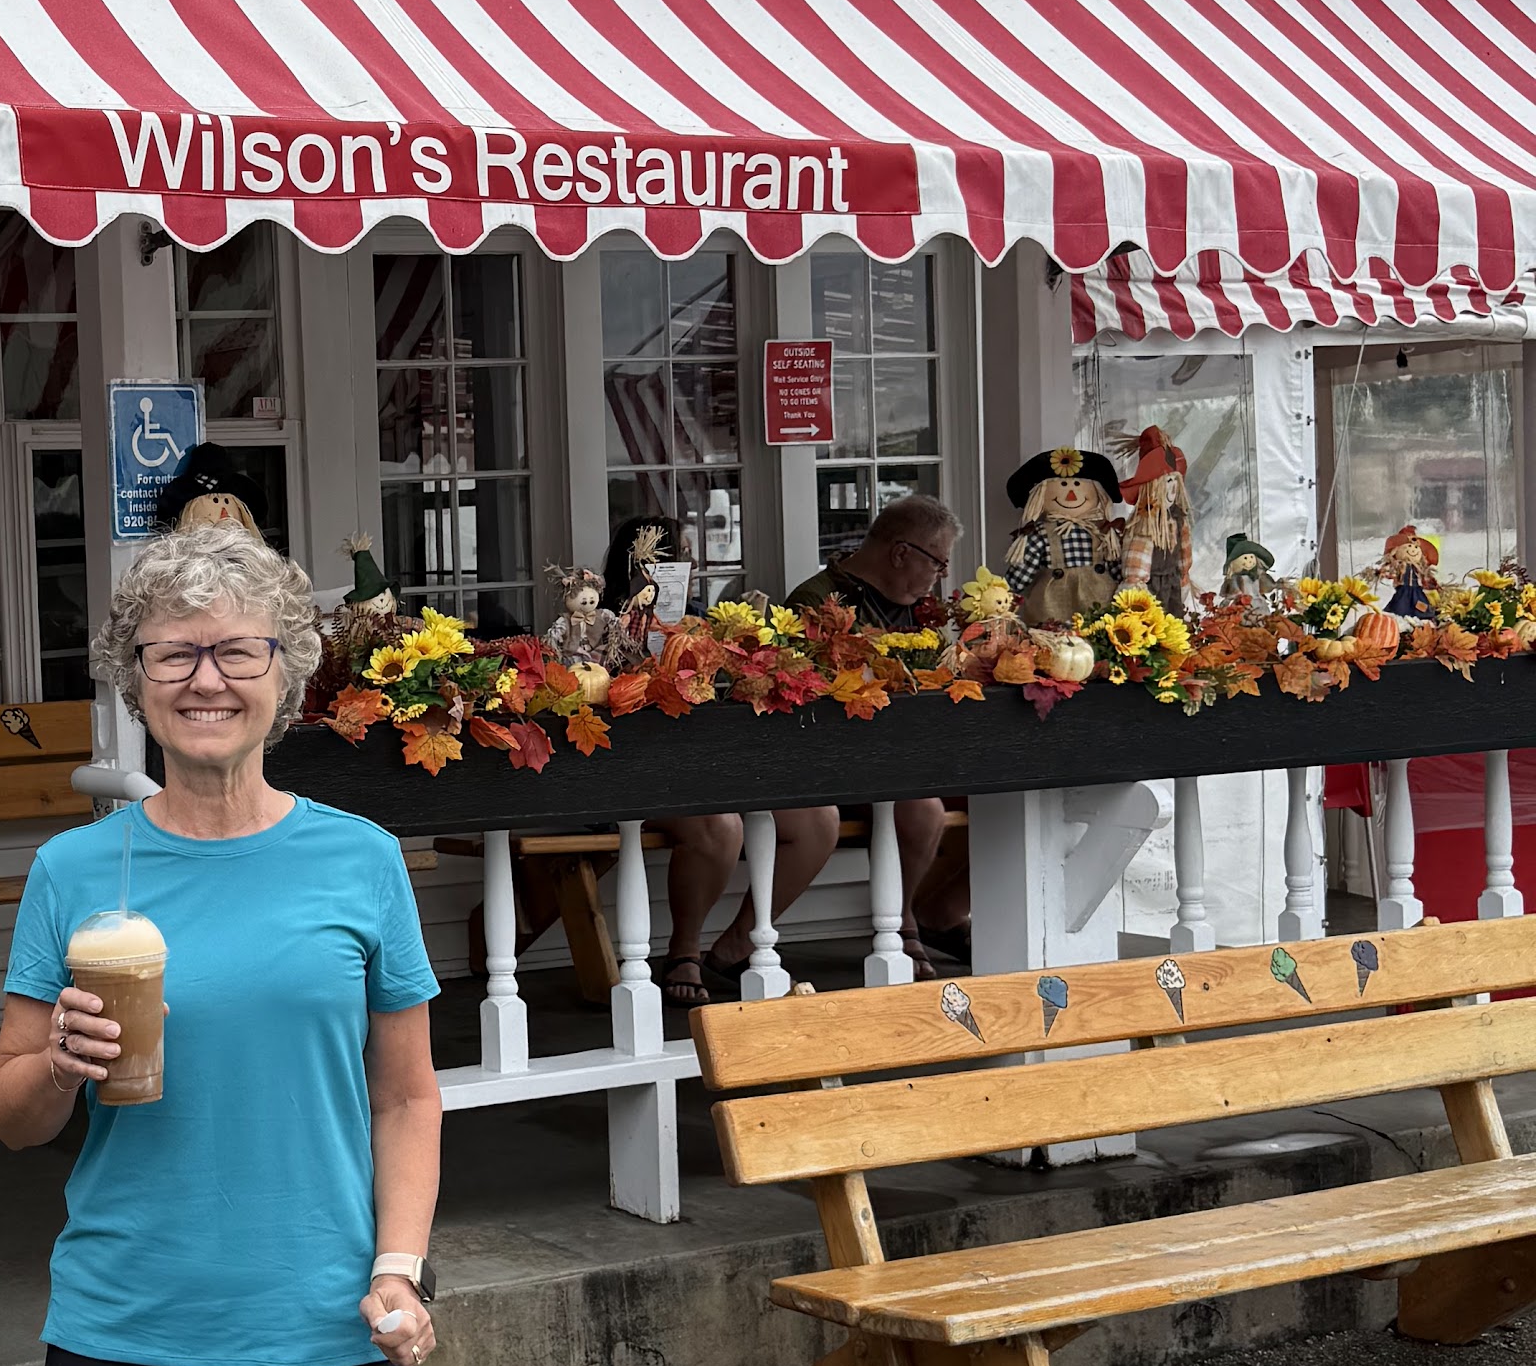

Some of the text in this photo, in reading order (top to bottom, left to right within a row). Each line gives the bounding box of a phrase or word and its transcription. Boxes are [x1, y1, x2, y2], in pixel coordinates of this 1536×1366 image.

[104, 109, 850, 213] Wilson's Restaurant
[784, 347, 816, 357] OUTSIDE
[772, 359, 825, 370] SELF SEATING
[787, 375, 809, 383] Service
[779, 387, 821, 396] NO CONES OR
[800, 397, 818, 405] ITEMS
[784, 411, 816, 419] Thank You
[137, 473, 177, 485] For entr
[120, 488, 158, 499] contact
[129, 500, 158, 513] inside
[123, 515, 158, 528] 920-8
